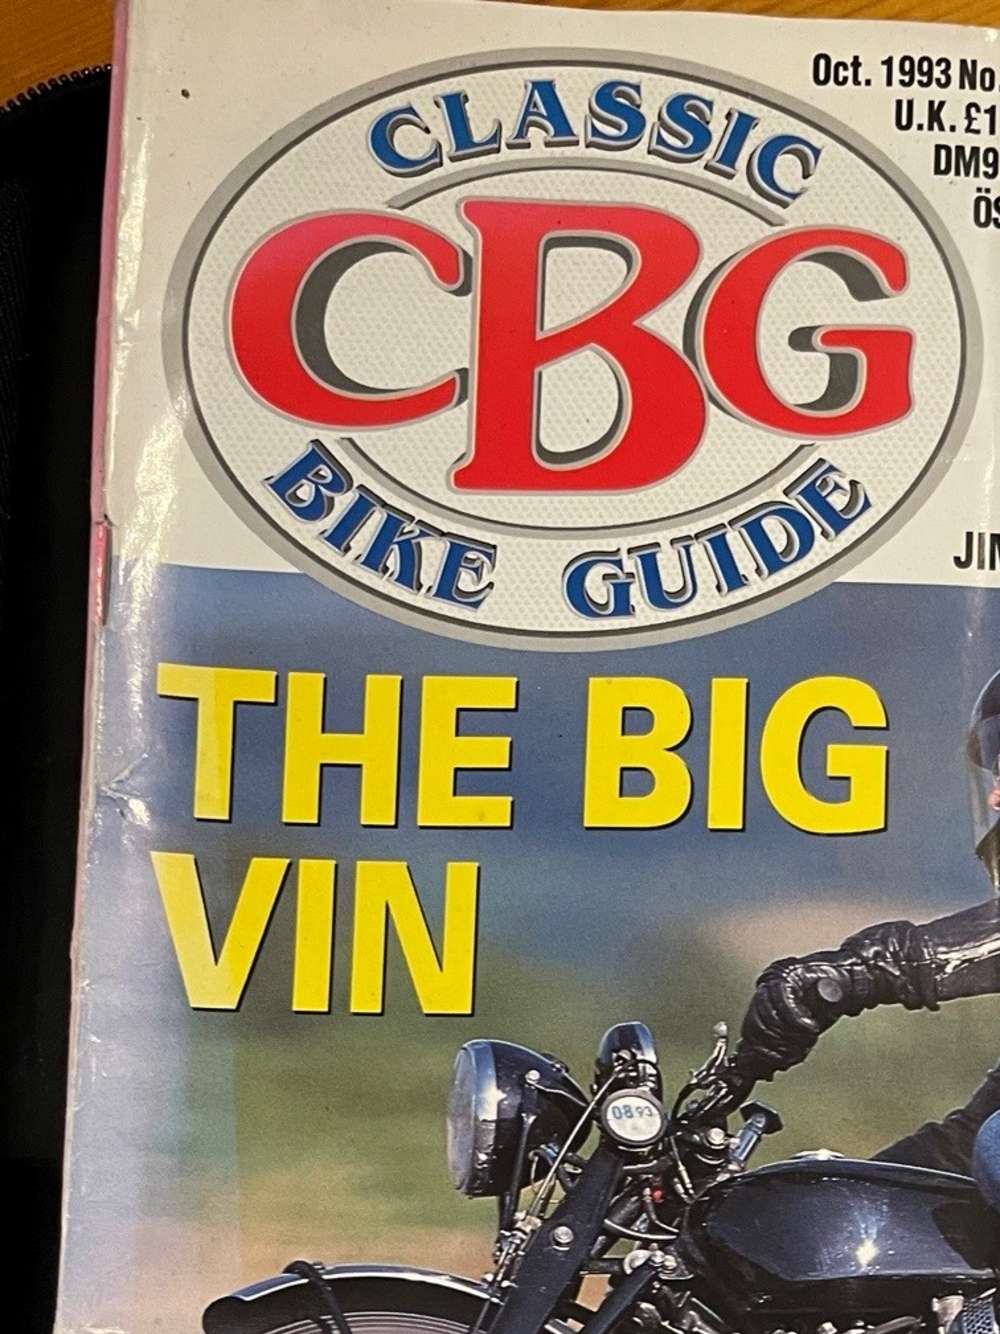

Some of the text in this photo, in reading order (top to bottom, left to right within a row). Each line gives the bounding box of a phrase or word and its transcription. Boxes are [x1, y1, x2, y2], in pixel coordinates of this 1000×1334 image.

[367, 78, 824, 210] CLASSIC
[812, 53, 872, 88] Oct.
[881, 54, 952, 89] 1993
[894, 98, 957, 134] U.K.
[229, 199, 916, 495] CBG
[263, 439, 873, 621] BIKE GUIDE
[156, 662, 891, 836] THE BIG
[149, 850, 481, 1017] VIN
